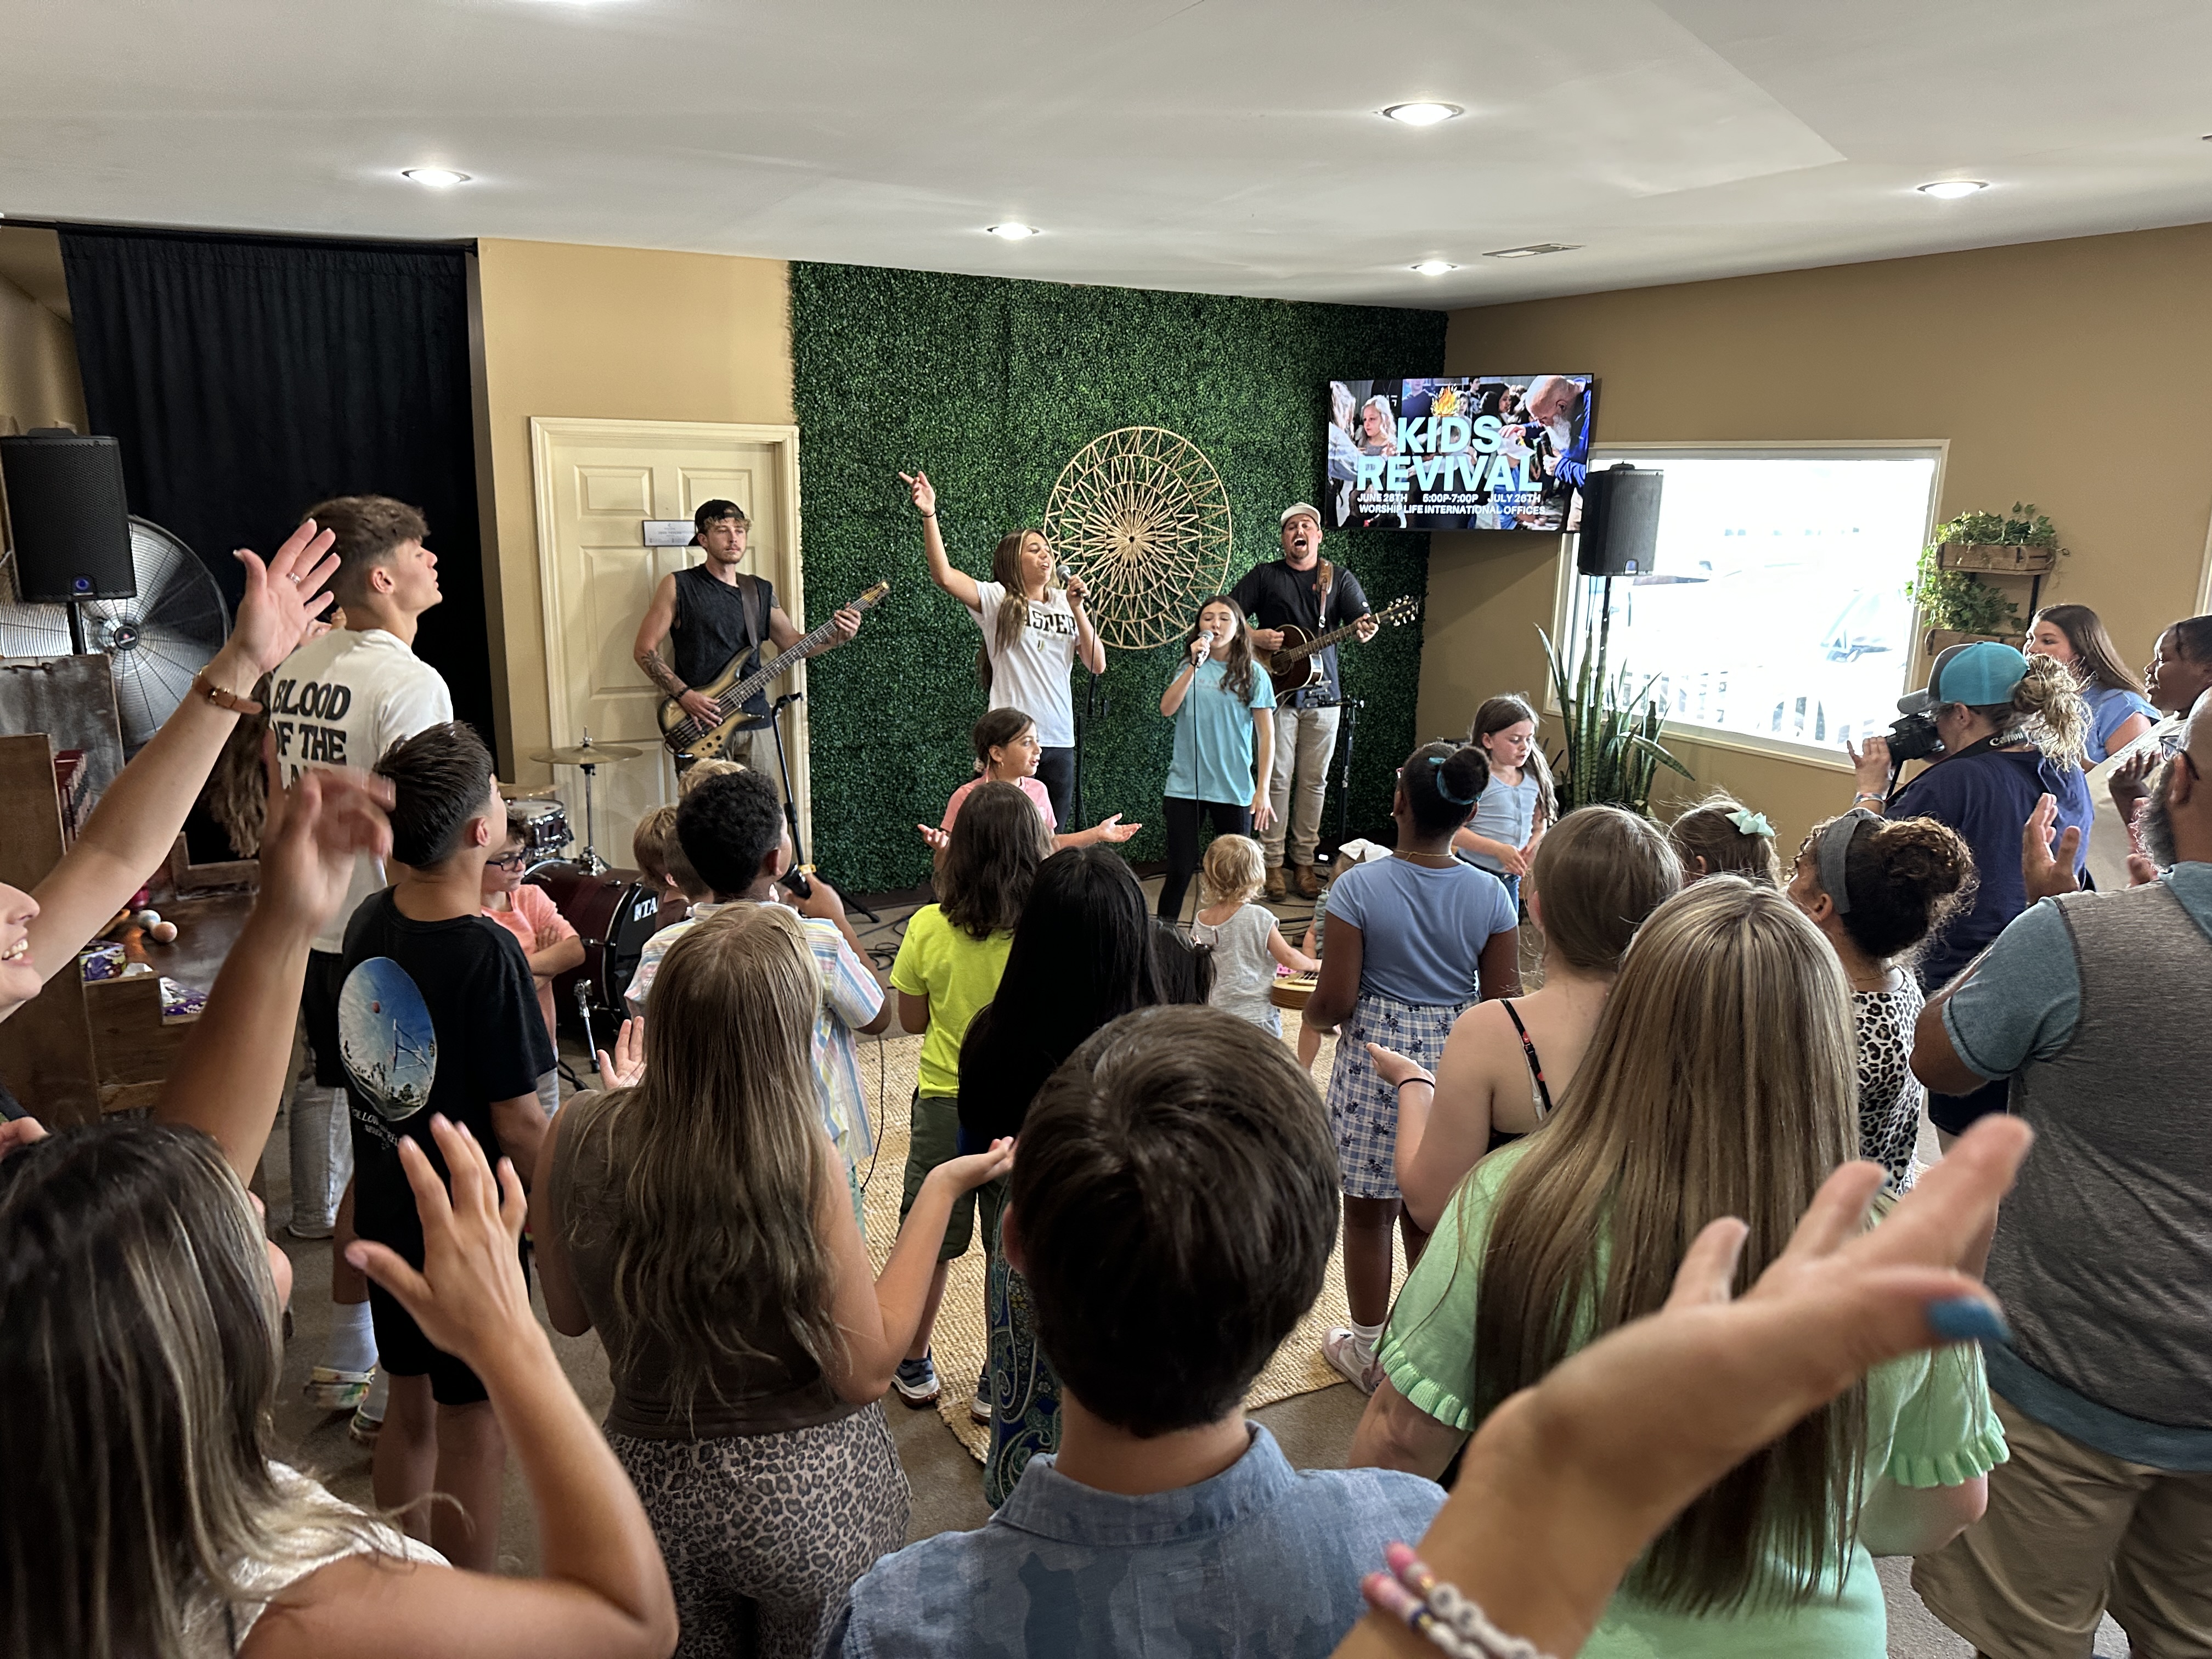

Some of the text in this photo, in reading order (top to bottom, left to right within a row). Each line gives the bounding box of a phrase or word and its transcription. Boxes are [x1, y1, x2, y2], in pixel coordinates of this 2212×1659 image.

[1397, 415, 1502, 454] KIDS
[1356, 455, 1543, 492] REVIVAL
[1357, 493, 1408, 503] JUNE 28TH
[1358, 504, 1546, 515] WORSHIP LIFE INTERNATIONAL OFFICES
[1487, 493, 1541, 503] JULY 26TH
[272, 679, 351, 721] BLOOD
[298, 723, 347, 766] THE
